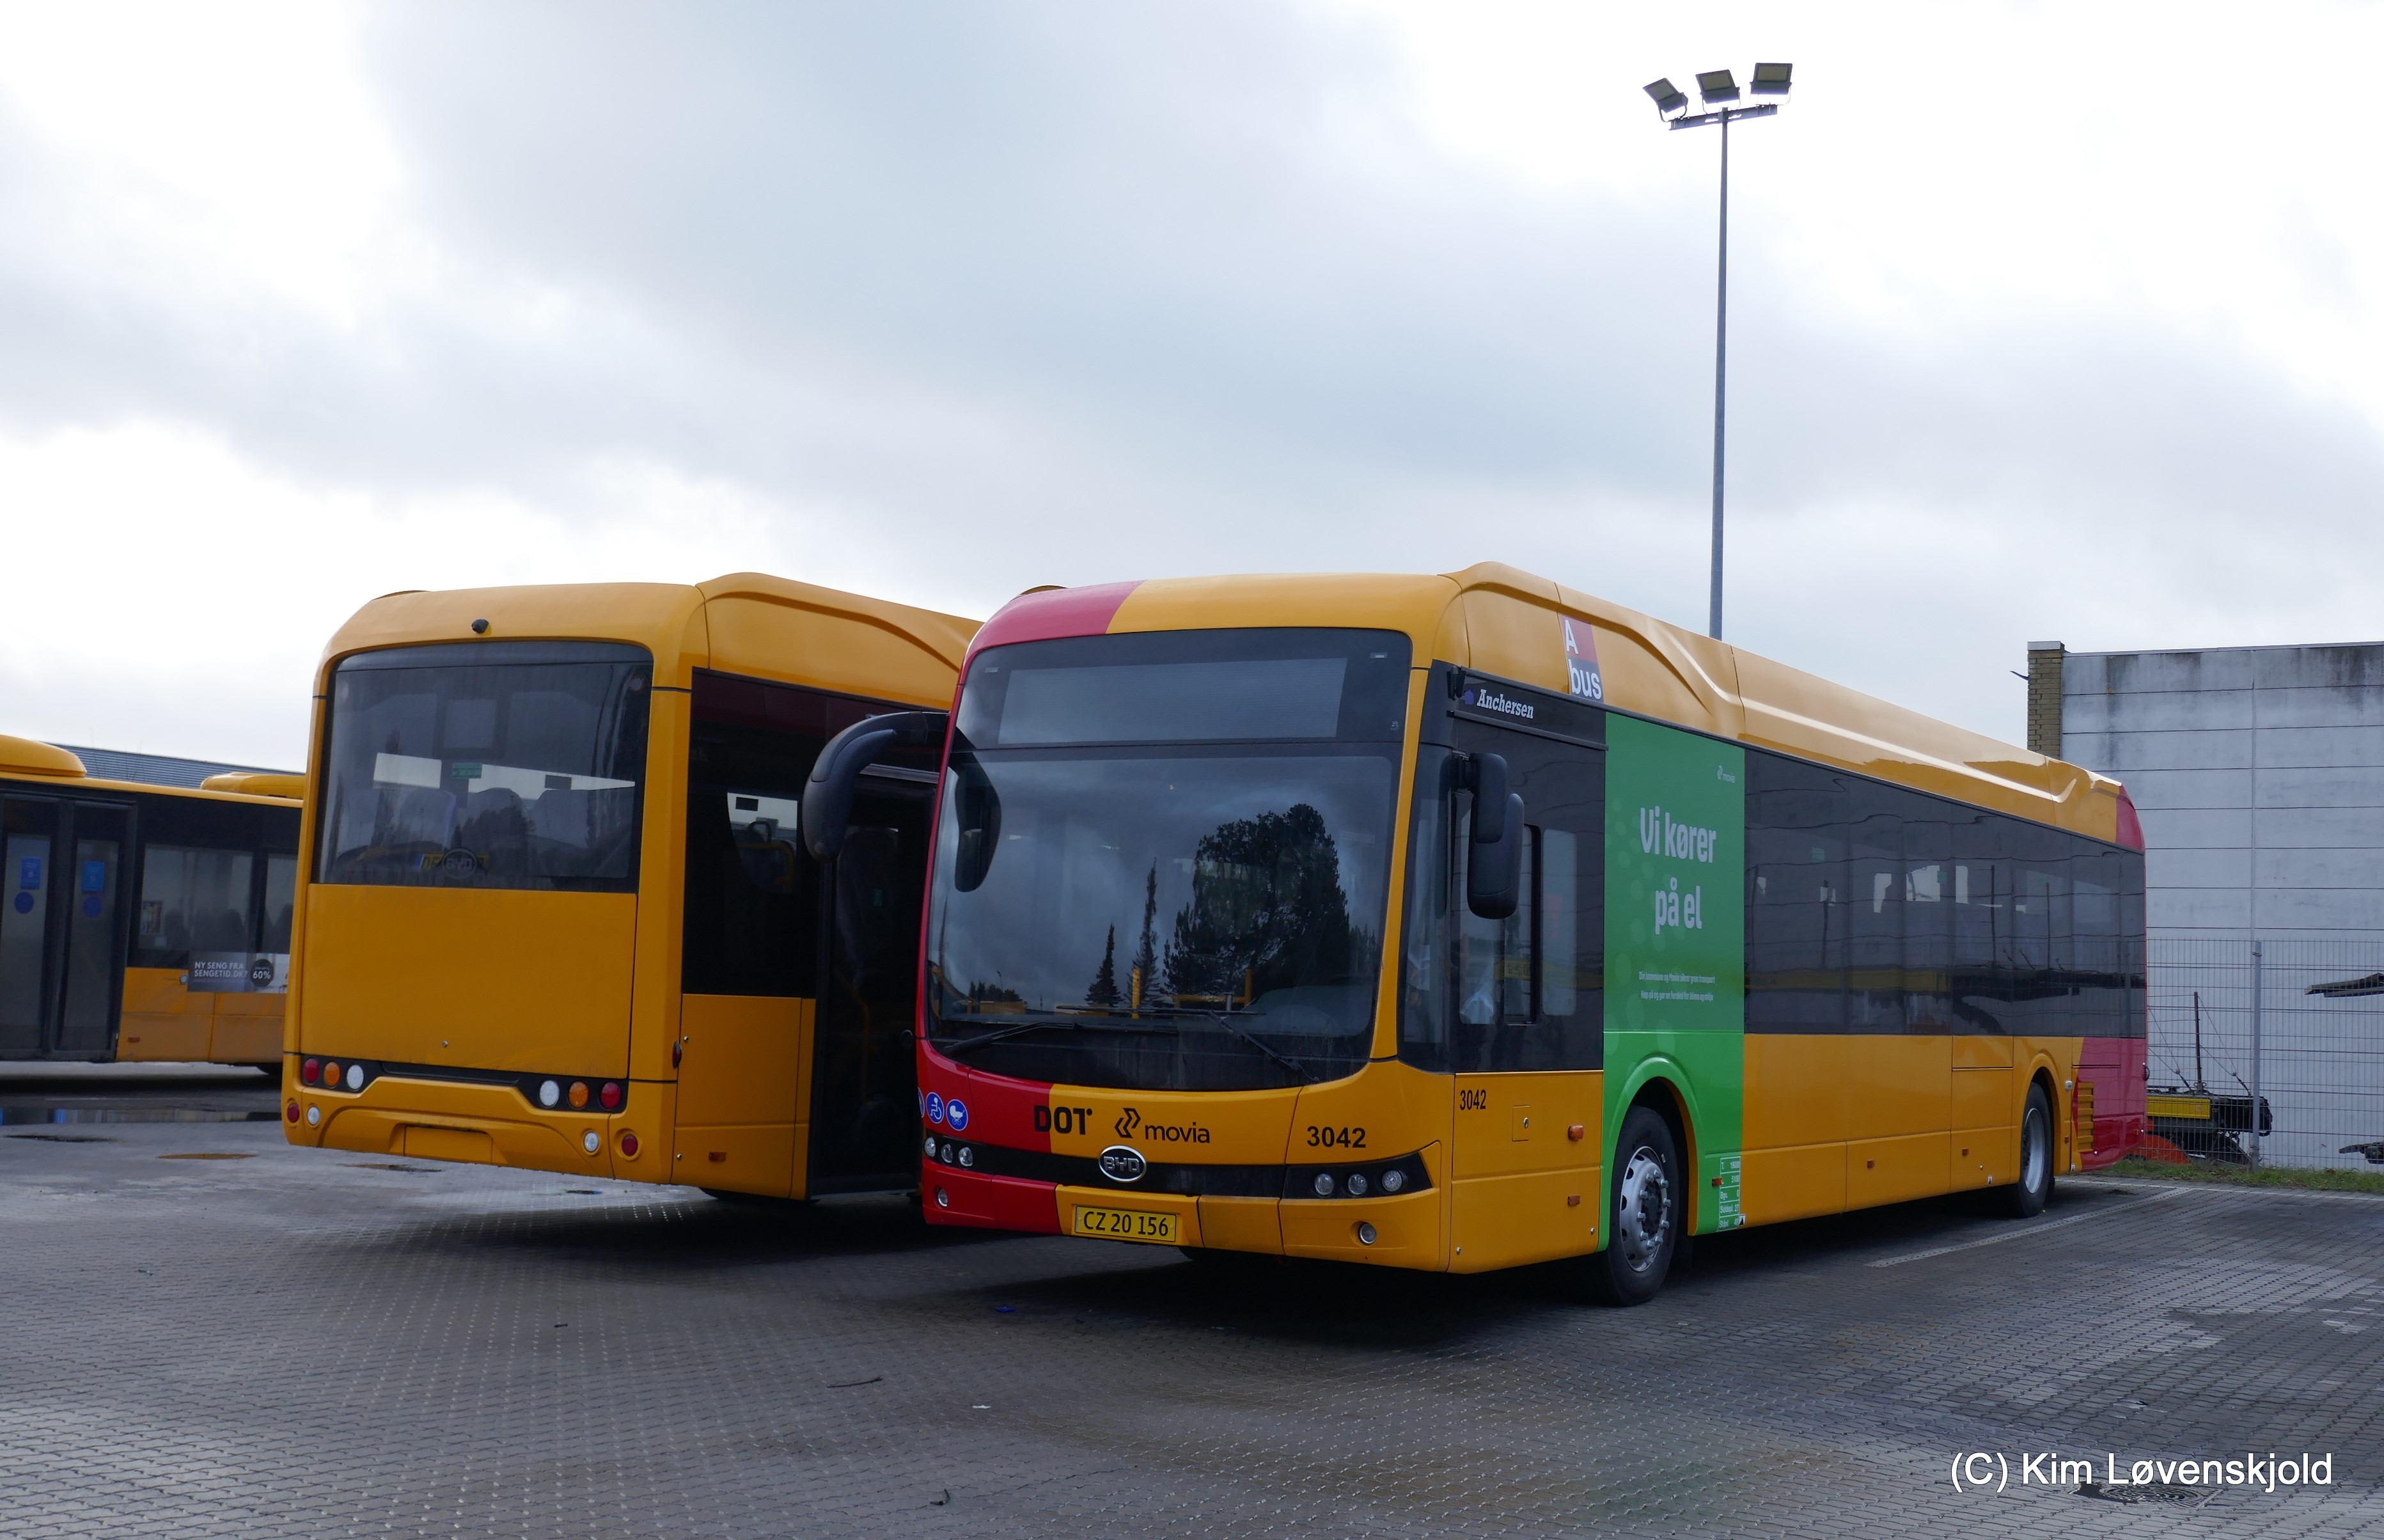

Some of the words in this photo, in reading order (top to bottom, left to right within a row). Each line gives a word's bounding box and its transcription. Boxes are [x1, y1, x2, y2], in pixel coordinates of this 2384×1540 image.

[1564, 620, 1578, 654] A
[1568, 659, 1603, 700] bus
[1477, 689, 1533, 719] Anchersen
[1640, 806, 1660, 855] Vi
[1665, 812, 1716, 863] kører
[1655, 877, 1679, 935] på
[1684, 886, 1702, 929] el
[253, 971, 271, 980] 60%
[1459, 1089, 1487, 1111] 3042
[1034, 1106, 1092, 1136] DOT
[1145, 1122, 1211, 1143] movia
[1306, 1126, 1367, 1149] 3042
[1103, 1155, 1140, 1173] BYD
[1083, 1211, 1106, 1231] CZ
[1111, 1213, 1132, 1234] 20
[1138, 1216, 1169, 1237] 156
